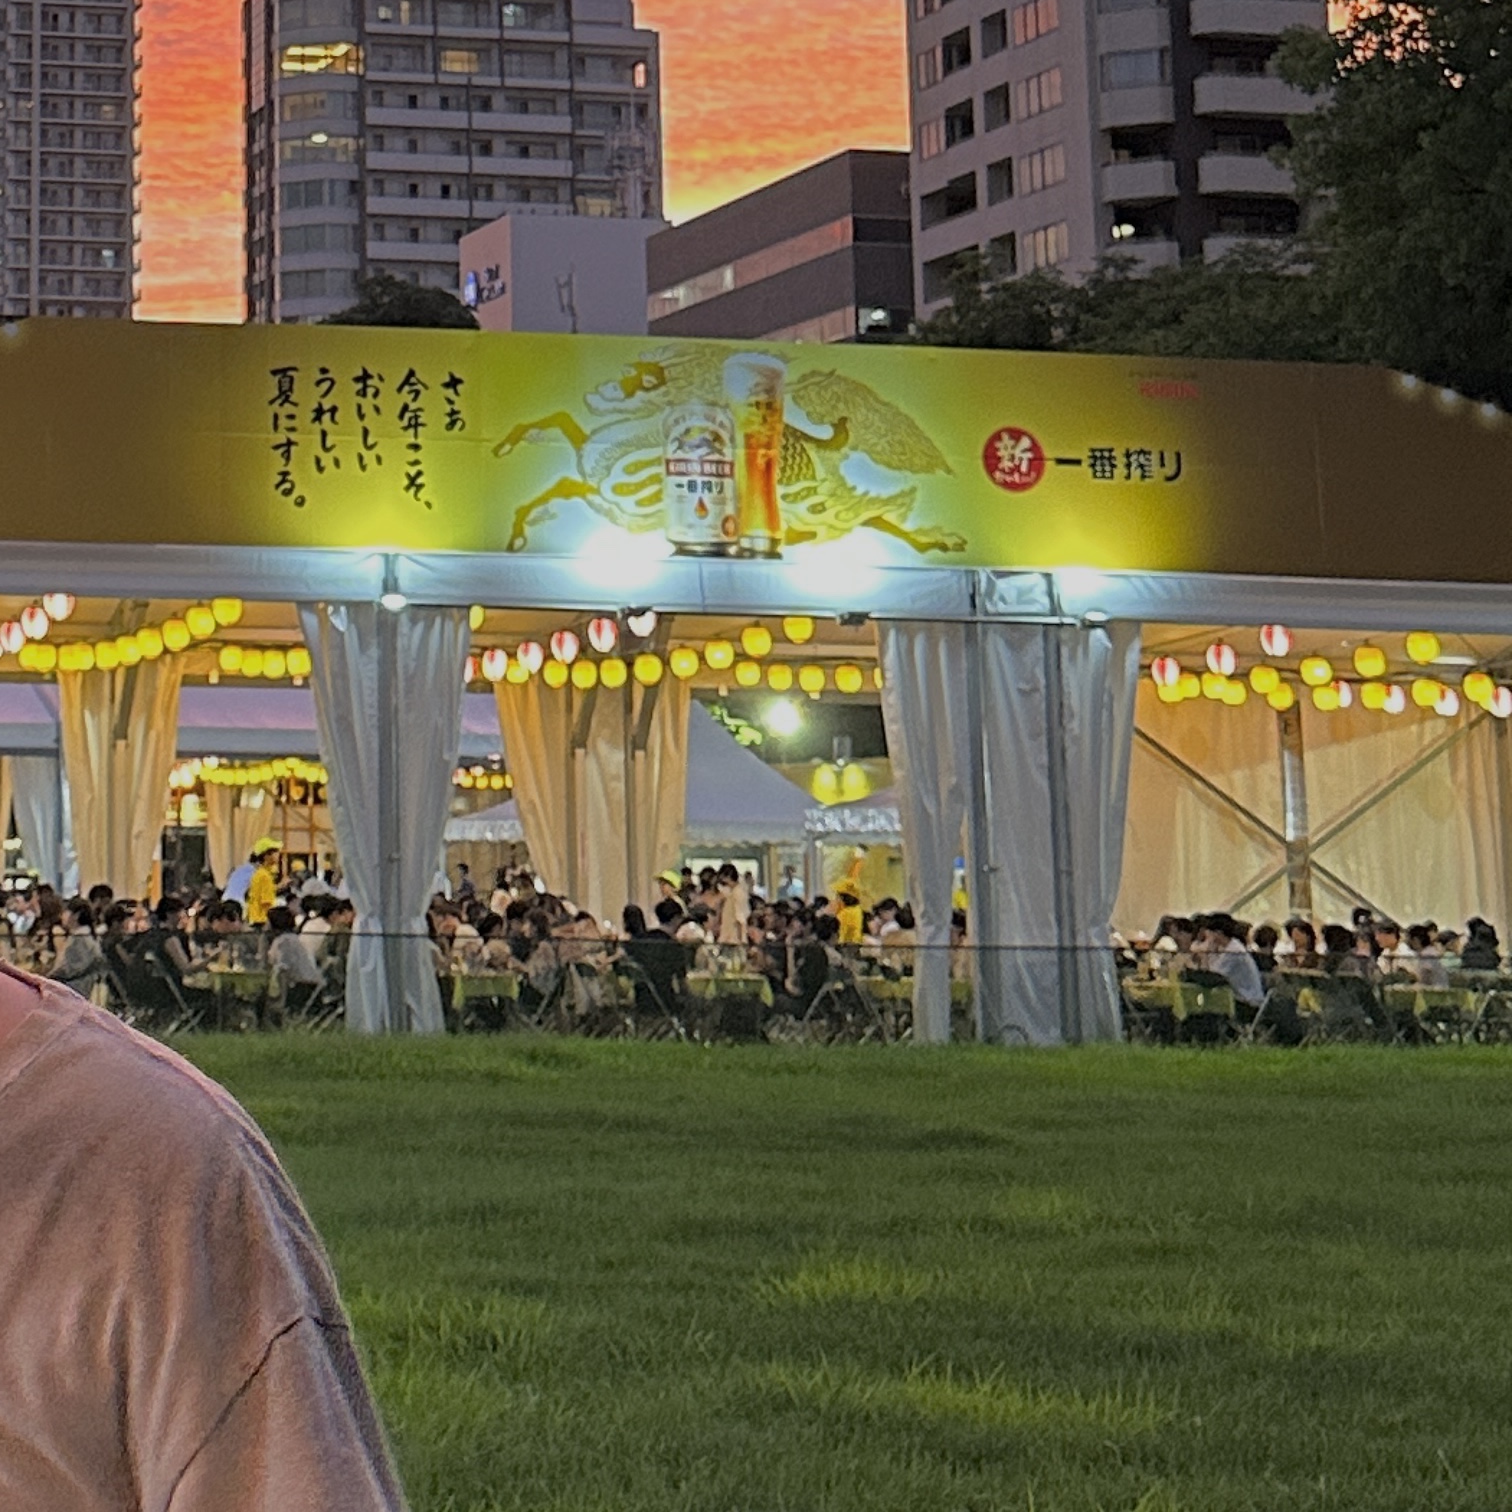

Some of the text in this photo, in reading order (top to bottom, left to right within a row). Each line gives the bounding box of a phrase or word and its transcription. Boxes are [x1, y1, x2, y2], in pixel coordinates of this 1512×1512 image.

[268, 366, 306, 508] 夏にする。
[311, 367, 341, 475] うれしい
[352, 366, 385, 473] おいしい
[440, 371, 466, 432] さあ
[1054, 447, 1182, 482] 一番搾り
